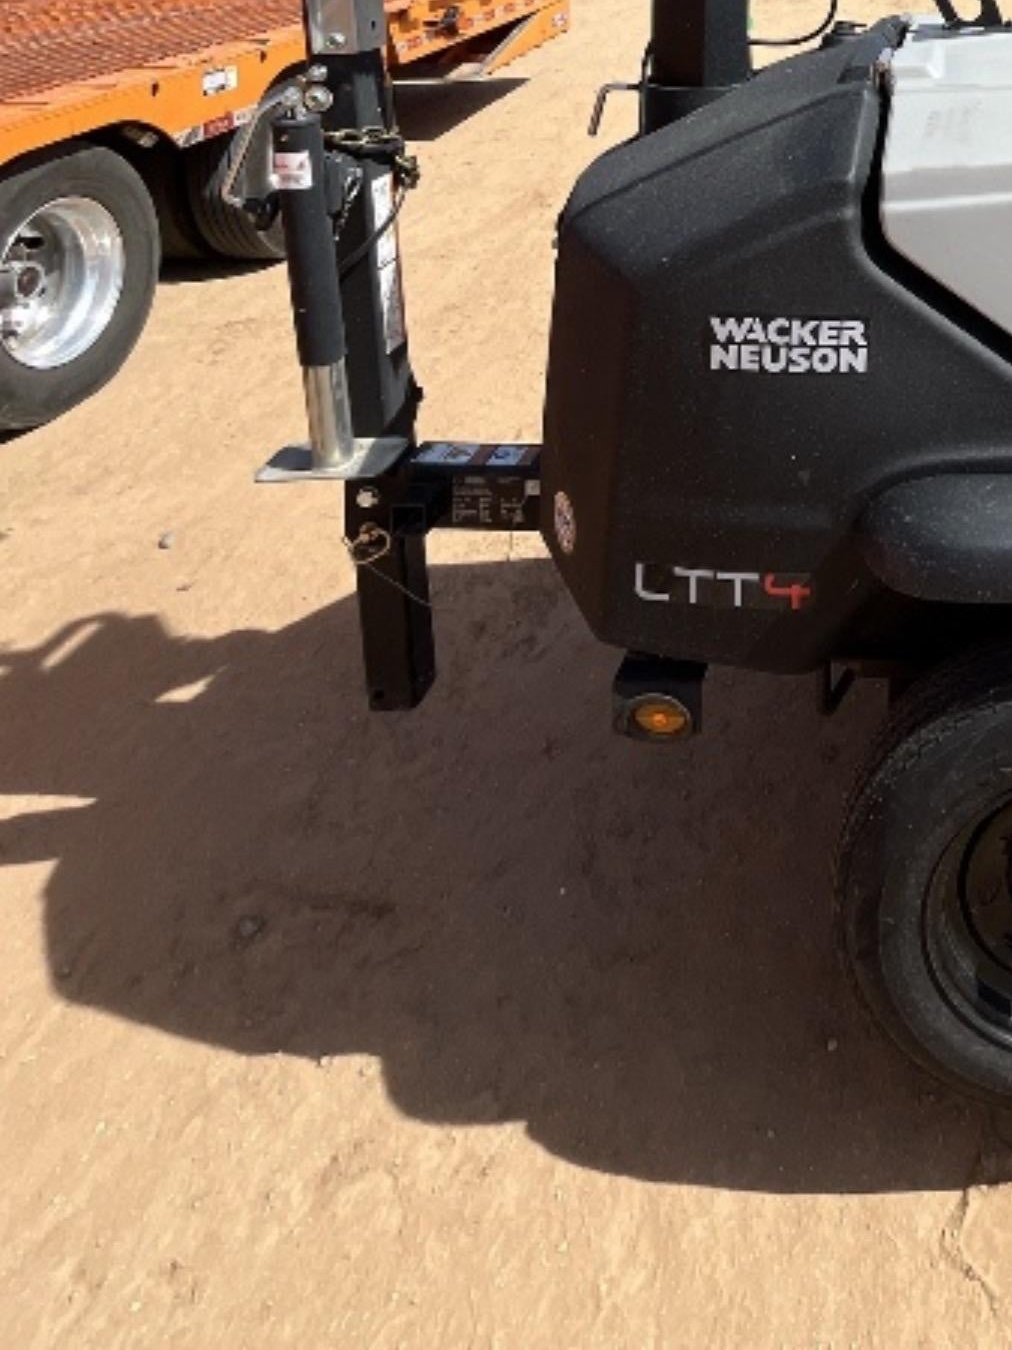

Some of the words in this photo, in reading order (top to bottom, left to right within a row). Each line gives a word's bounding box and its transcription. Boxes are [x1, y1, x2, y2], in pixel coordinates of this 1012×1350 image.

[710, 316, 868, 346] WACKER
[710, 345, 868, 373] NEUSON
[634, 563, 811, 610] LTT4
